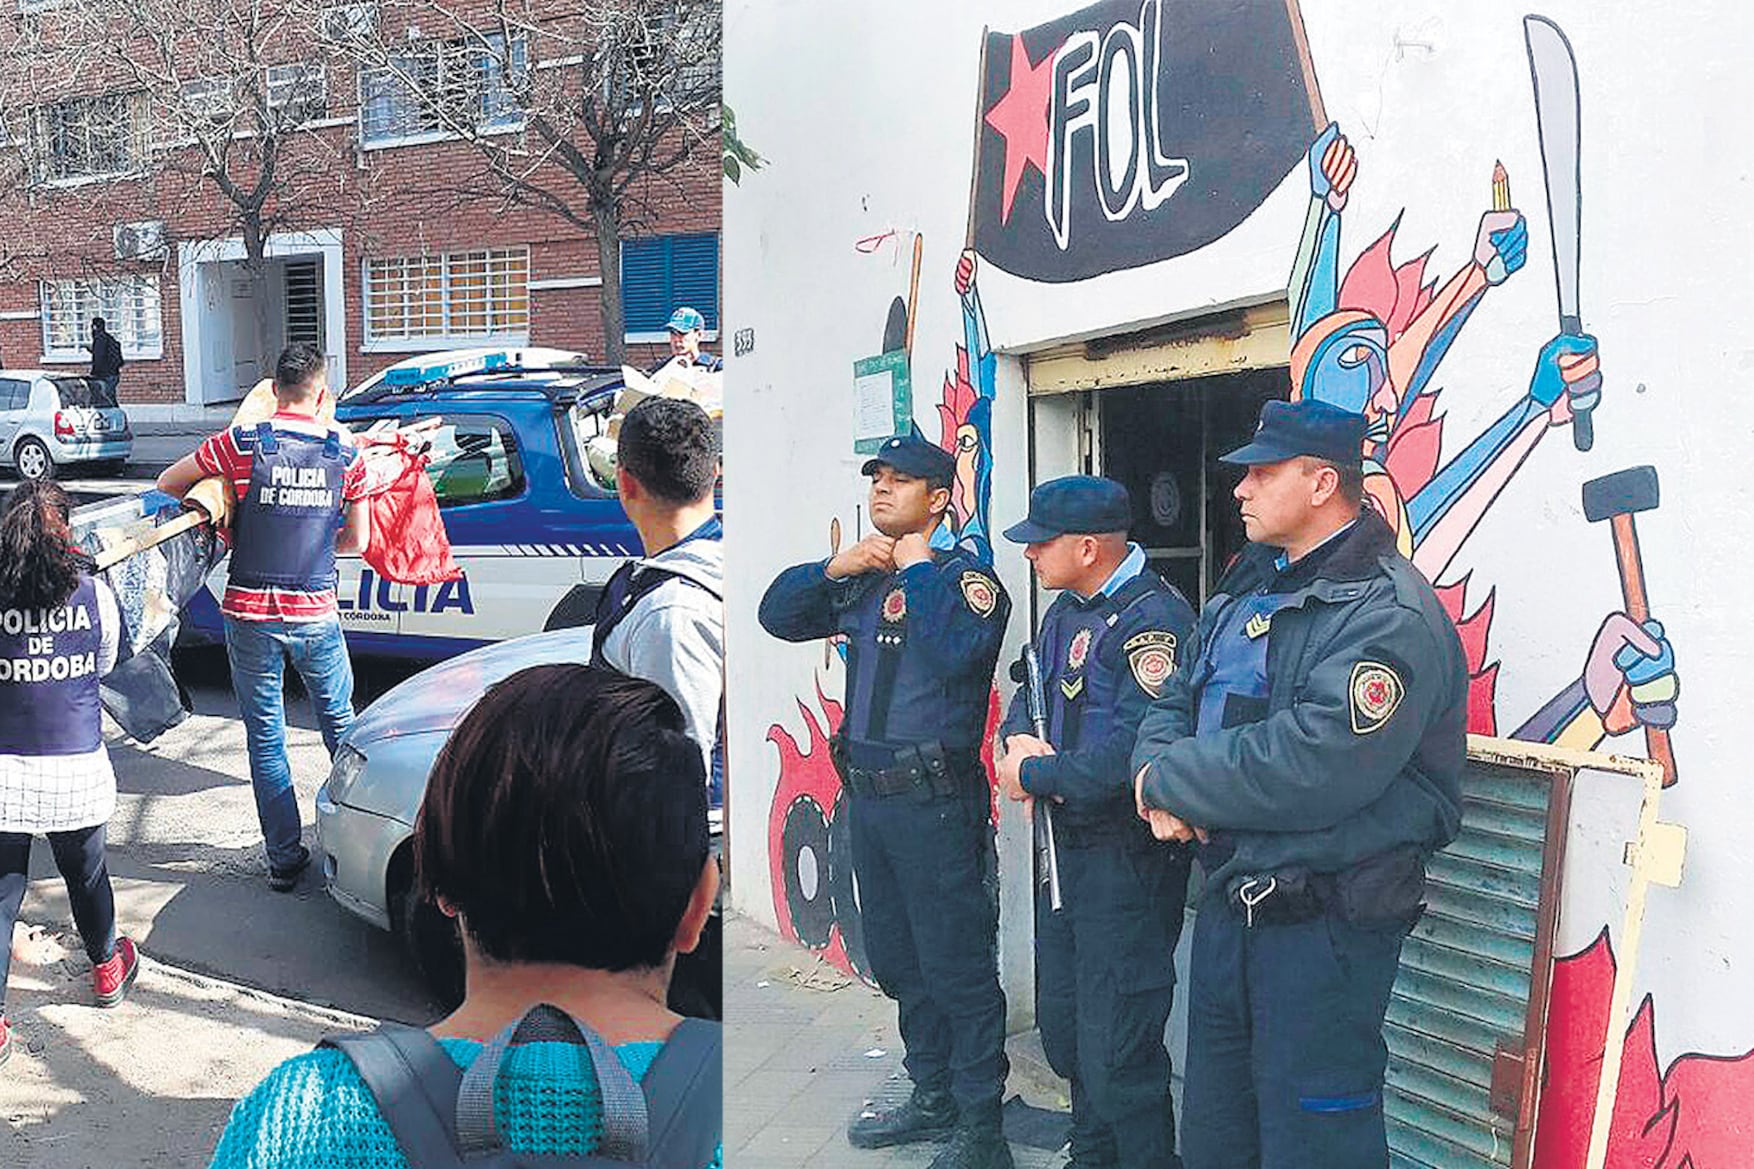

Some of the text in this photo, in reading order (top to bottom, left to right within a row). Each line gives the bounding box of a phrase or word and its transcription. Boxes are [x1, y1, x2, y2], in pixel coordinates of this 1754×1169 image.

[1045, 0, 1190, 250] FOL
[271, 466, 327, 487] POLICIA
[260, 486, 333, 508] DE CORDOBA
[0, 604, 92, 635] OLICIA
[28, 636, 54, 655] DE
